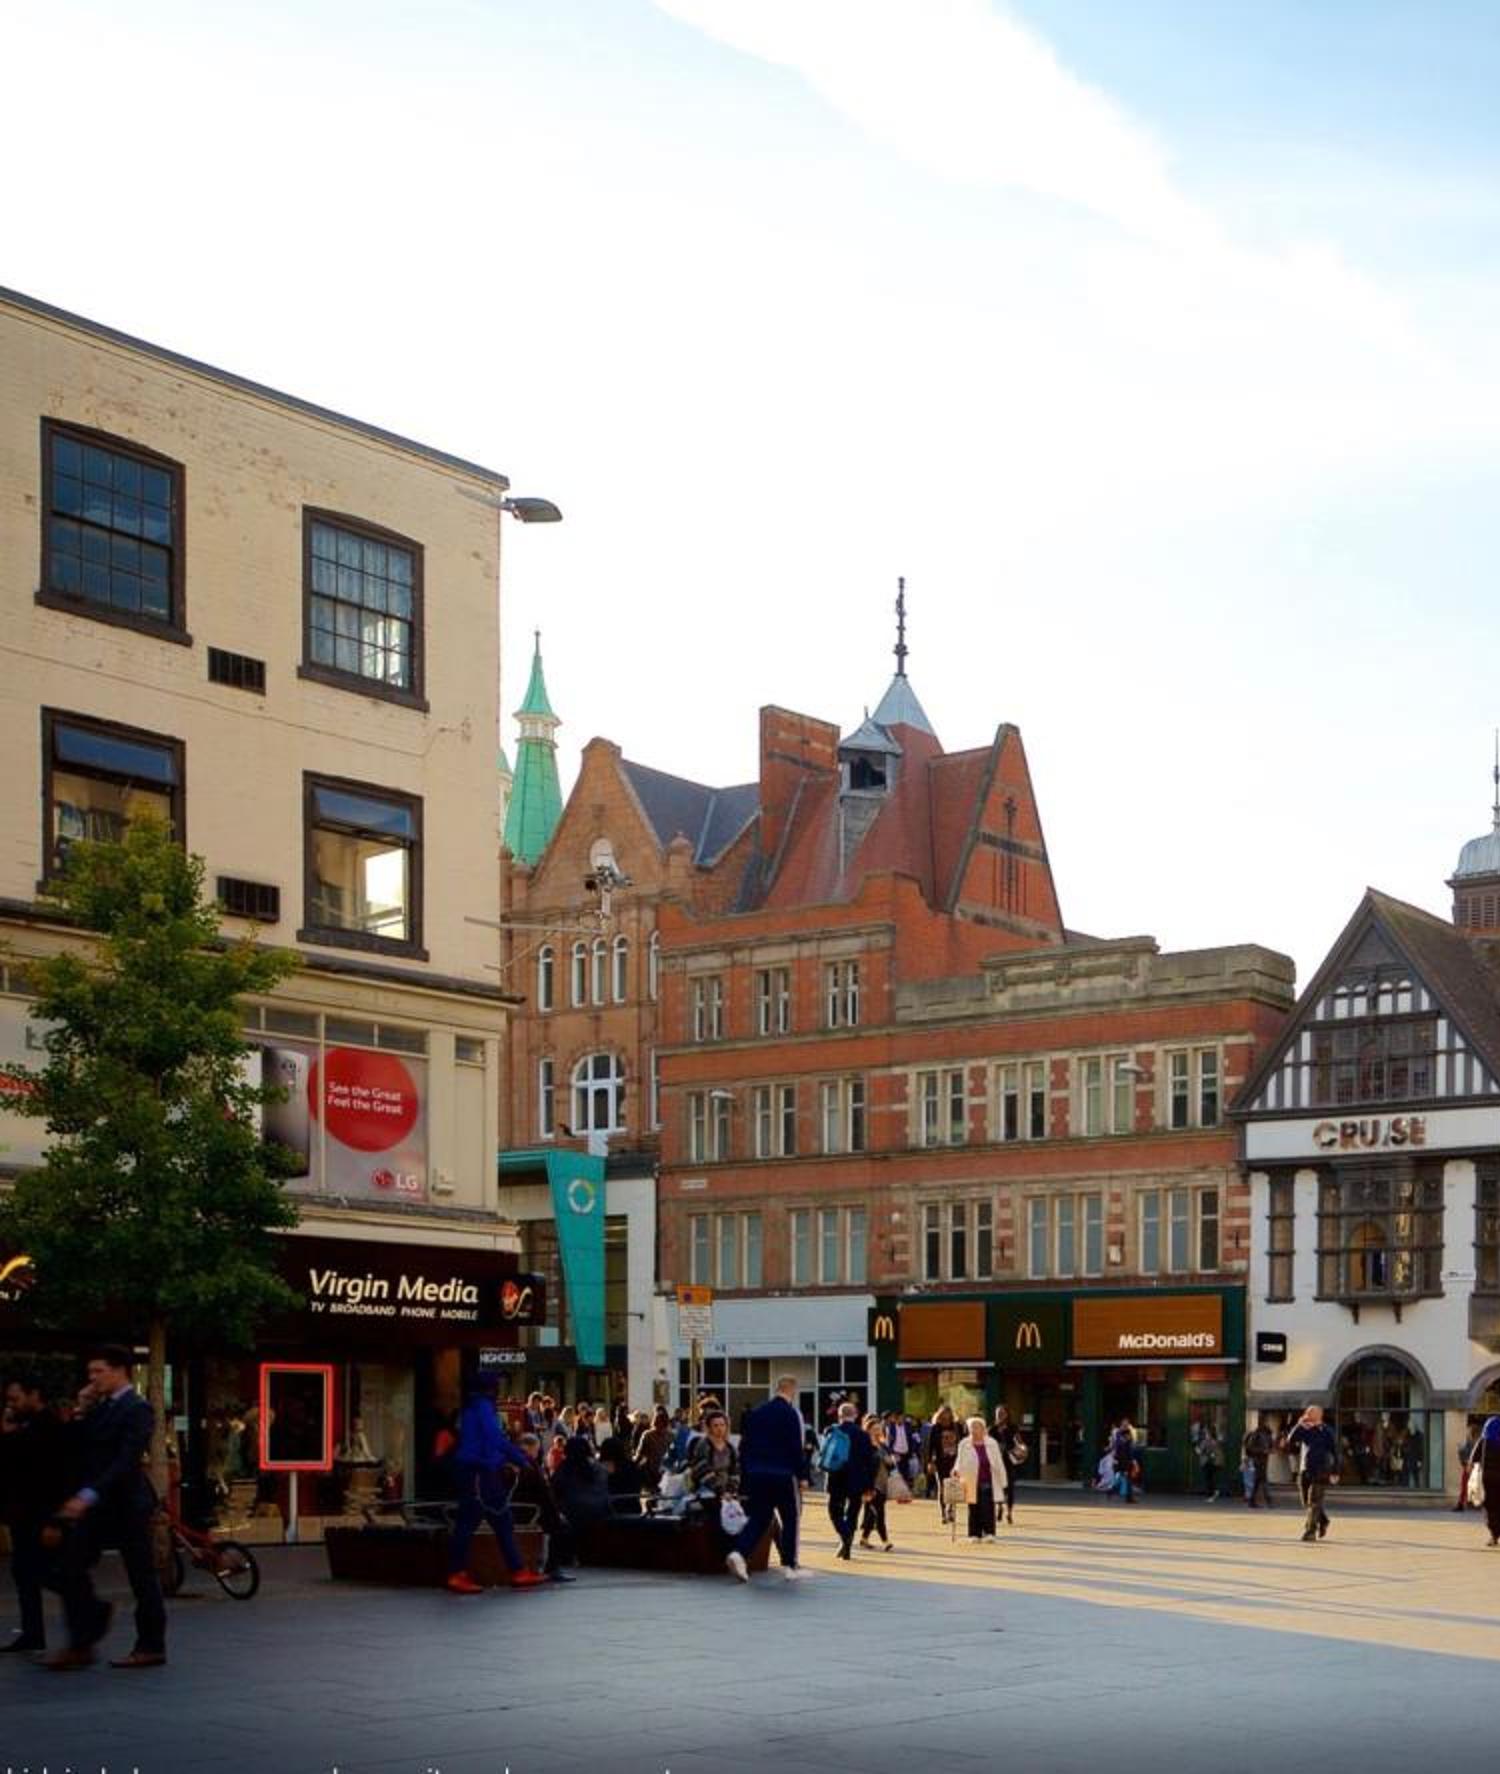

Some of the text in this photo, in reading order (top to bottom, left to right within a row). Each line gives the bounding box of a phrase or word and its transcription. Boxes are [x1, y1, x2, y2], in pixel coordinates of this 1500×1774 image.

[329, 1081, 402, 1101] See the Great
[328, 1094, 403, 1115] Feel the Great
[1312, 1117, 1426, 1149] CRUISE
[396, 1174, 418, 1190] LG
[309, 1269, 479, 1304] Virgin Media
[311, 1303, 478, 1321] TV BROADBAND PHONE MOBILE
[1119, 1333, 1215, 1349] McDonald's
